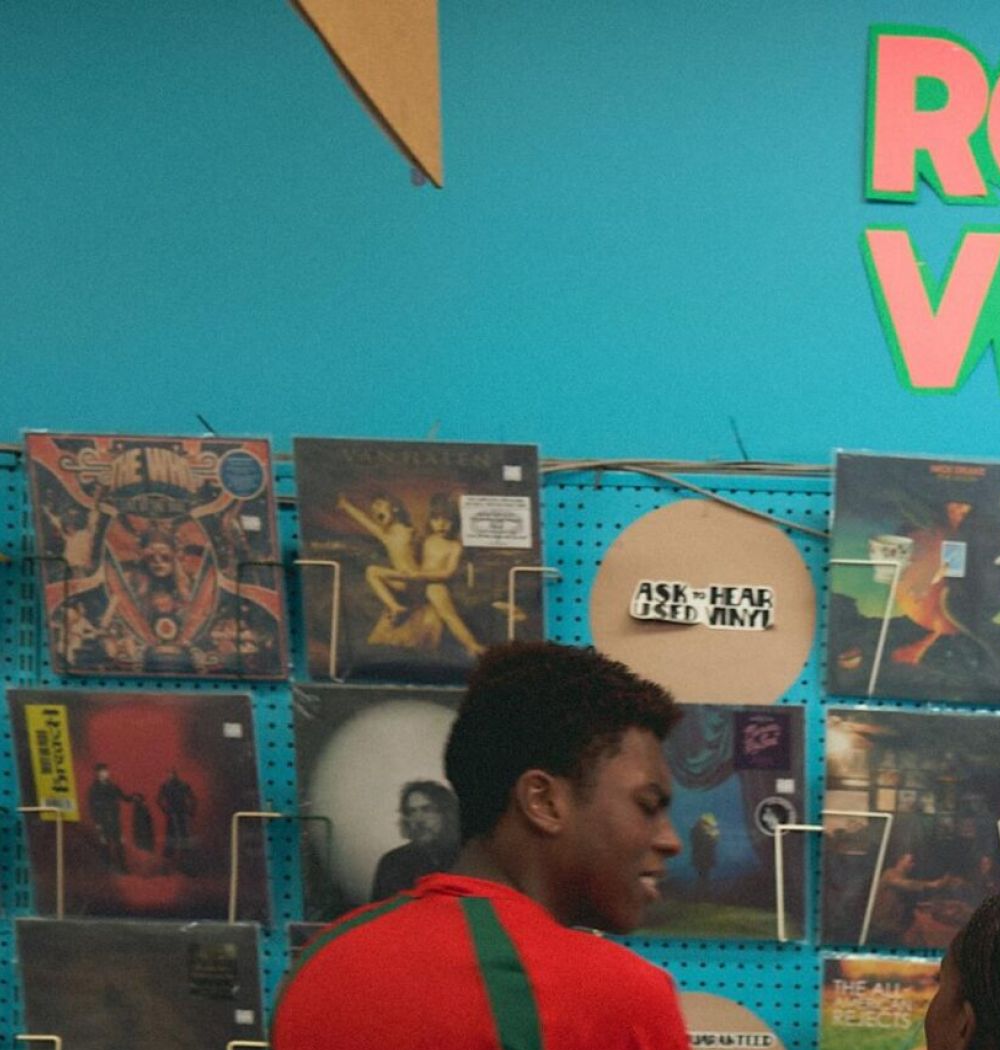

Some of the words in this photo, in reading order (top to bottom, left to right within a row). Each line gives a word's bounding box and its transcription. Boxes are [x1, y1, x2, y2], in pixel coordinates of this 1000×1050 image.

[637, 582, 688, 604] ASK
[708, 585, 774, 609] HEAR
[634, 602, 699, 621] USED
[705, 606, 773, 630] VINYL
[832, 979, 867, 996] THE
[831, 1009, 912, 1030] REJECTS
